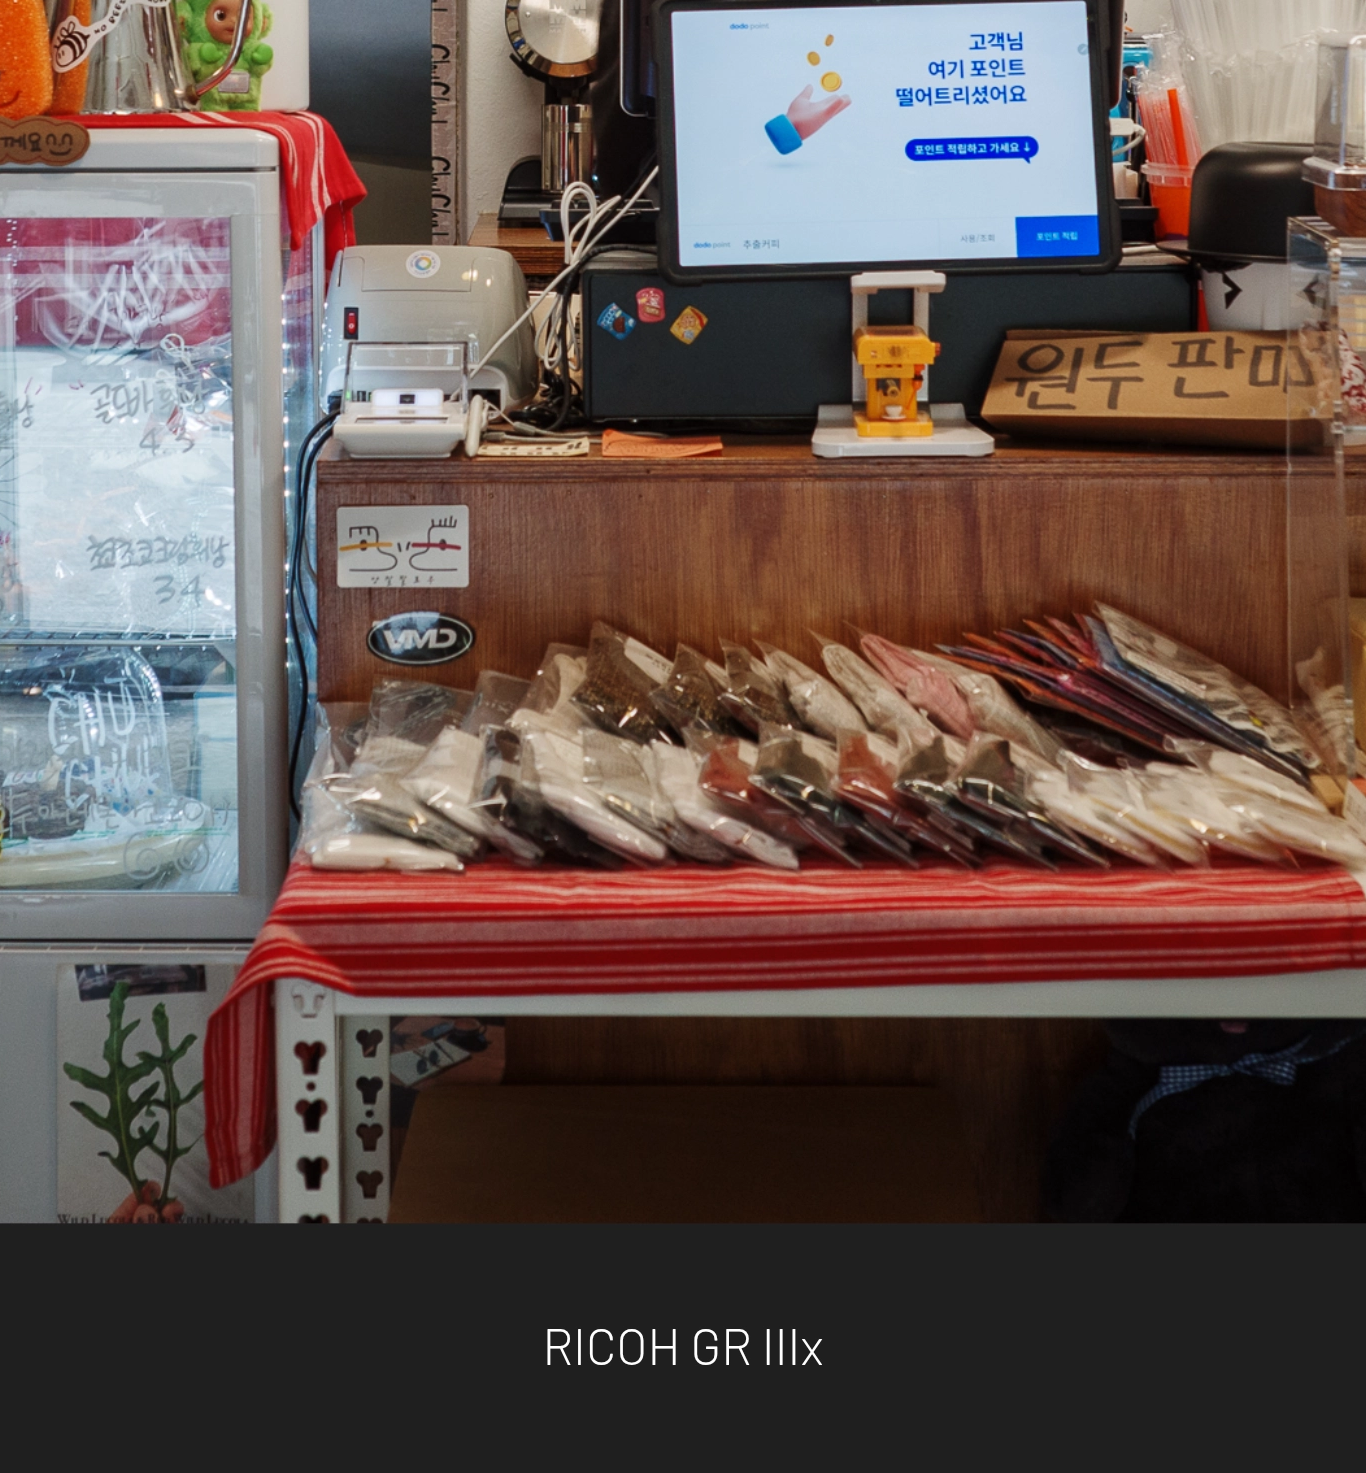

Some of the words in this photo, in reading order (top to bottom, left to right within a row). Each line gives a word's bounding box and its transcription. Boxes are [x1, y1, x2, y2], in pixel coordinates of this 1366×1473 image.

[729, 22, 749, 31] dodo
[750, 22, 770, 32] point
[968, 31, 1025, 53] 고객님
[927, 58, 966, 81] 여기
[969, 57, 1027, 79] 포인트
[895, 84, 1028, 108] 떨어트리셨어요
[913, 143, 945, 157] 포인트
[947, 142, 988, 156] 적립하고
[989, 141, 1021, 155] 가세요
[693, 241, 711, 250] dodo
[712, 240, 731, 251] point
[743, 238, 781, 251] 추출커피
[960, 232, 996, 244] 사용/조회
[1035, 231, 1060, 242] 포인트
[1004, 340, 1145, 411] 원두
[381, 628, 458, 650] VMD
